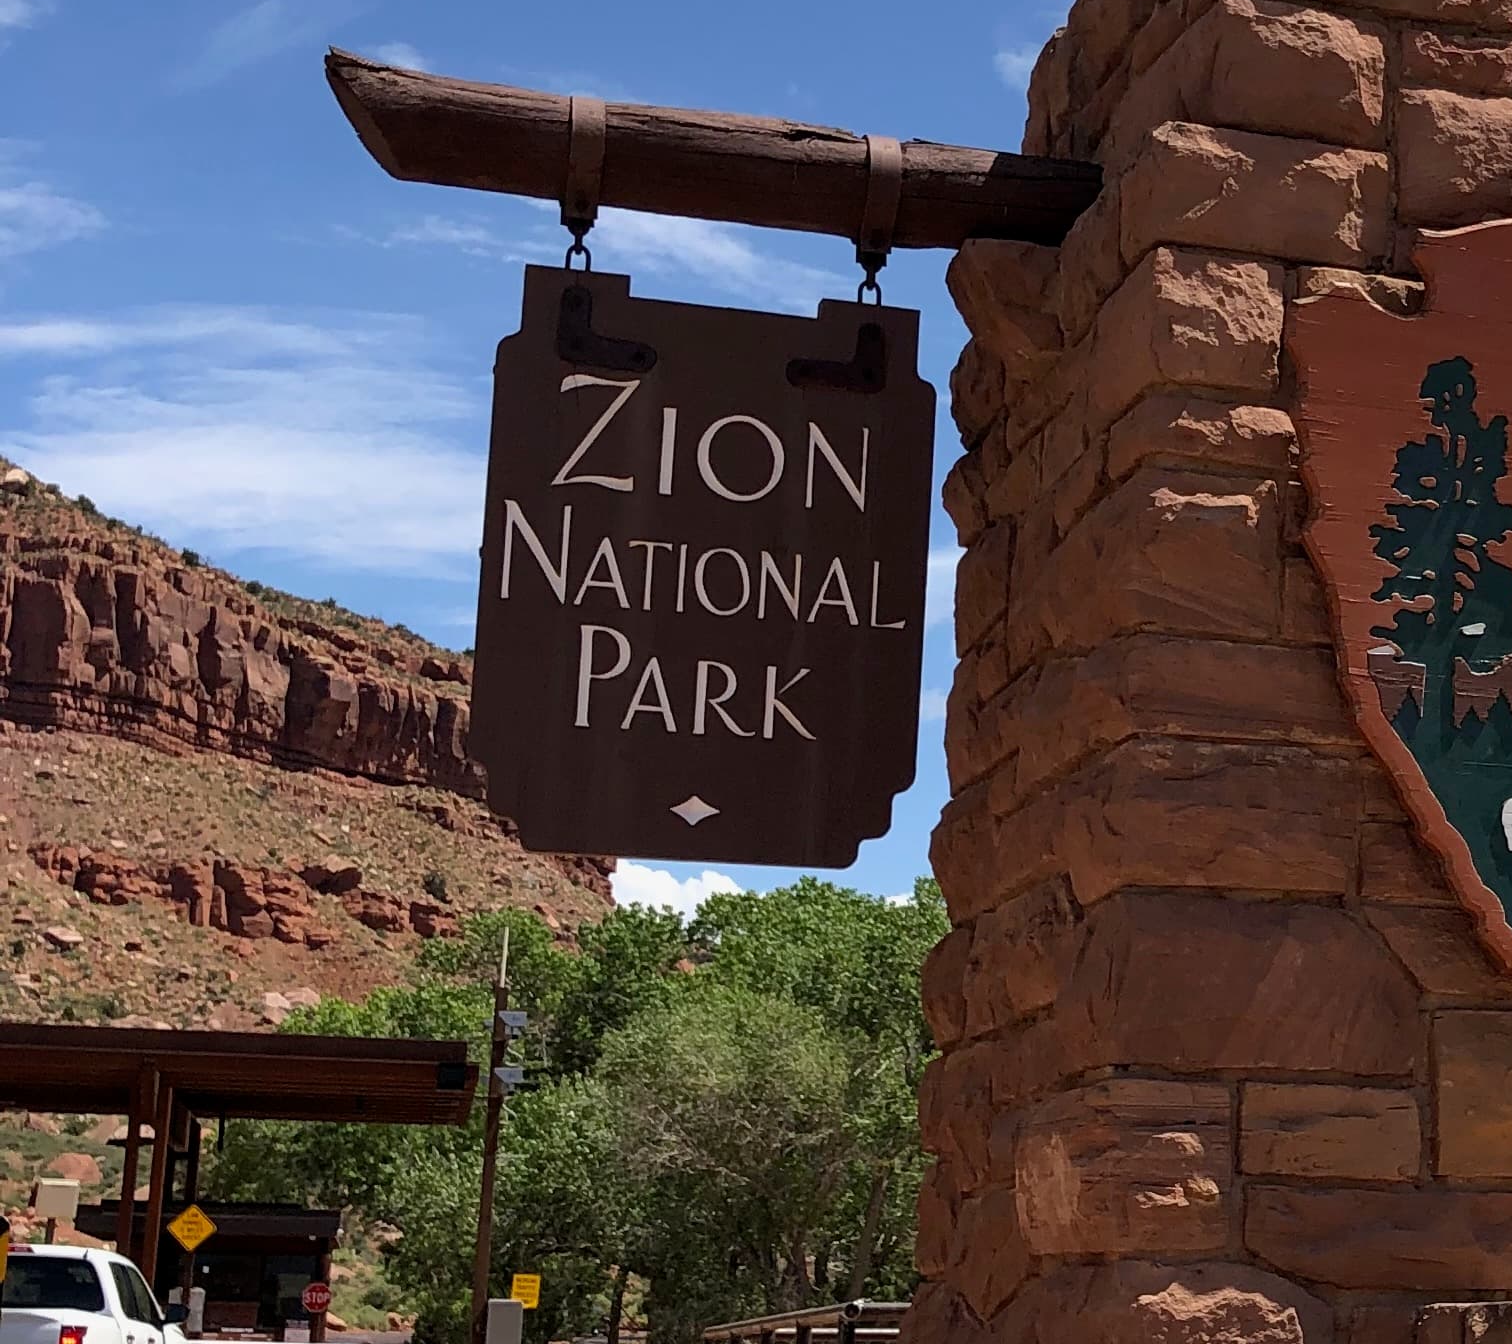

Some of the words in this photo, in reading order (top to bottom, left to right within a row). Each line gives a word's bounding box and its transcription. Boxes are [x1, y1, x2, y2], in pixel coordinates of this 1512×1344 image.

[551, 374, 870, 513] ZION
[500, 499, 906, 629] NATIONAL
[574, 624, 816, 740] PARK
[304, 1291, 330, 1304] STOP
